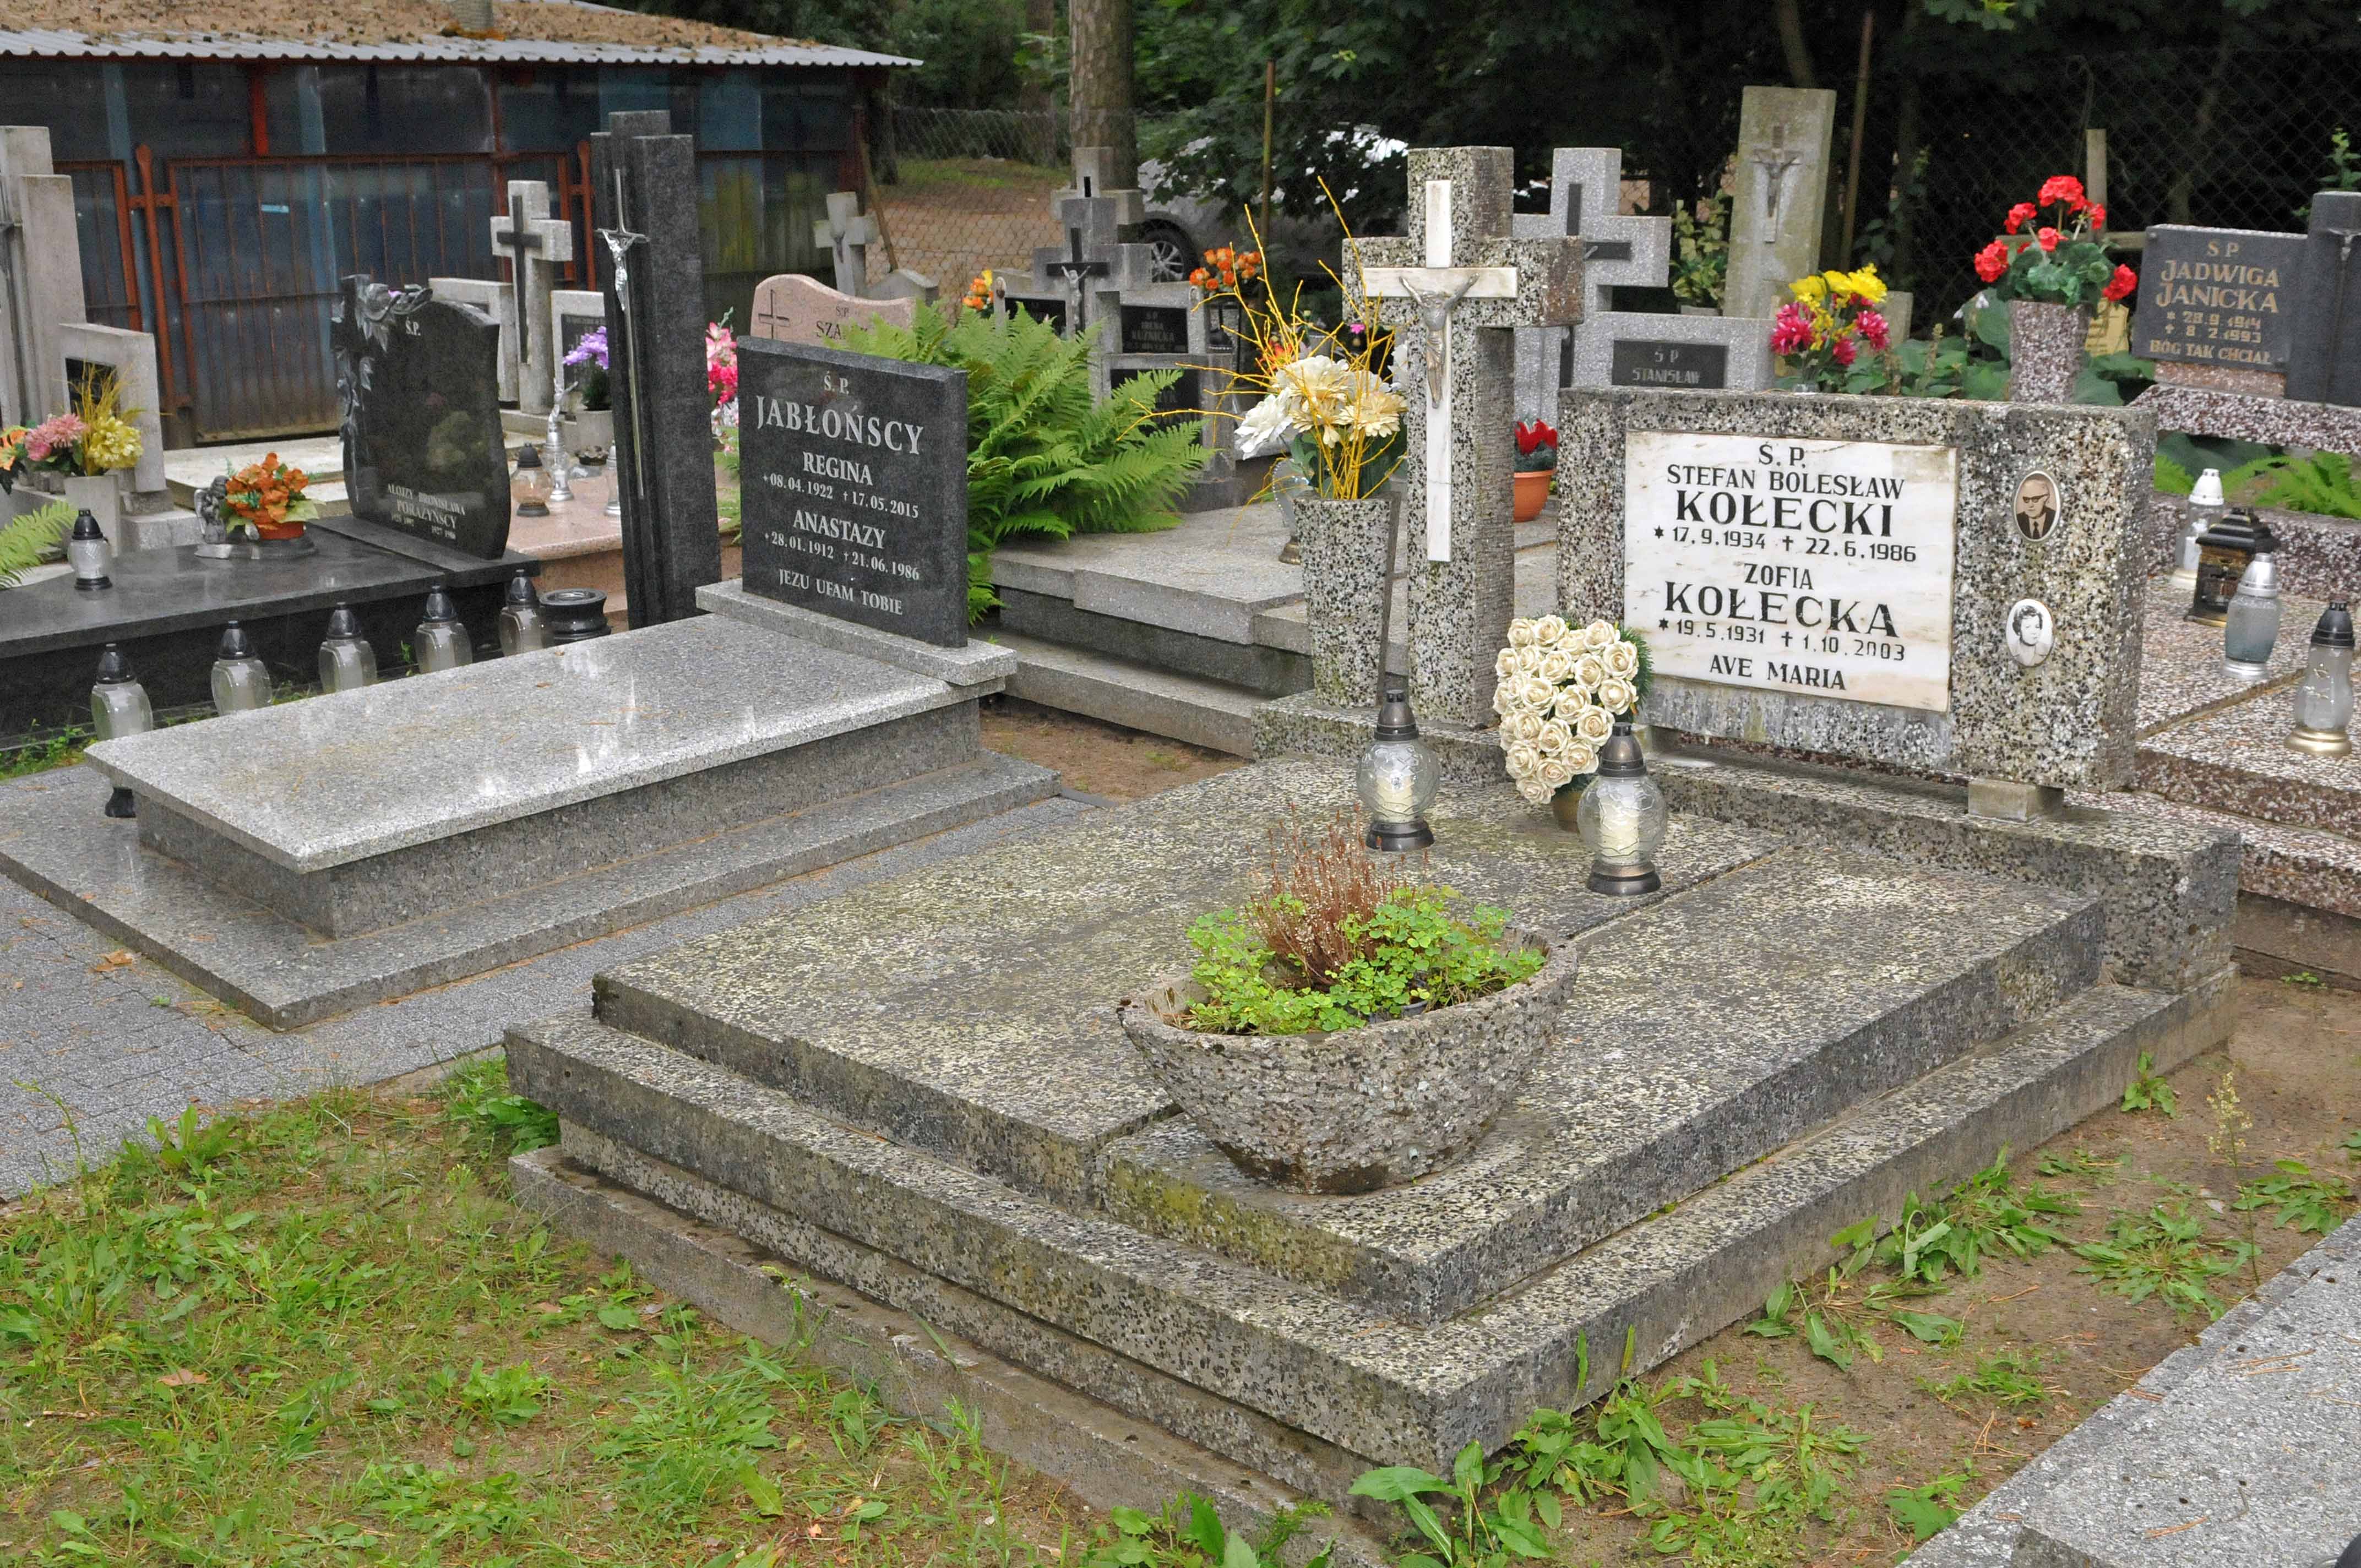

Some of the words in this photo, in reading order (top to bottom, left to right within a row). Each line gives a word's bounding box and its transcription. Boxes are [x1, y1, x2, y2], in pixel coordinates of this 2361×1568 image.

[2161, 260, 2280, 287] JADWIGA
[2156, 282, 2278, 313] JANICKA
[2185, 343, 2215, 358] TAK
[1632, 368, 1701, 384] STANISŁAW
[756, 395, 924, 455] JABŁOŃSCY
[802, 451, 873, 486] REGINA
[1667, 464, 1756, 489] STEFAN
[1769, 471, 1906, 500] BOLESŁAW
[387, 483, 414, 500] ALOJZY
[792, 509, 886, 549] ANASTAZY
[1676, 489, 1894, 537] KOŁECKI
[779, 568, 810, 590] JEZU
[816, 579, 855, 602] UFAM
[860, 590, 904, 616] TOBIE
[1744, 563, 1815, 590] ZOFIA
[1664, 581, 1900, 639] KOŁECKA
[1710, 654, 1753, 678] AVE
[1767, 661, 1847, 691] MARIA
